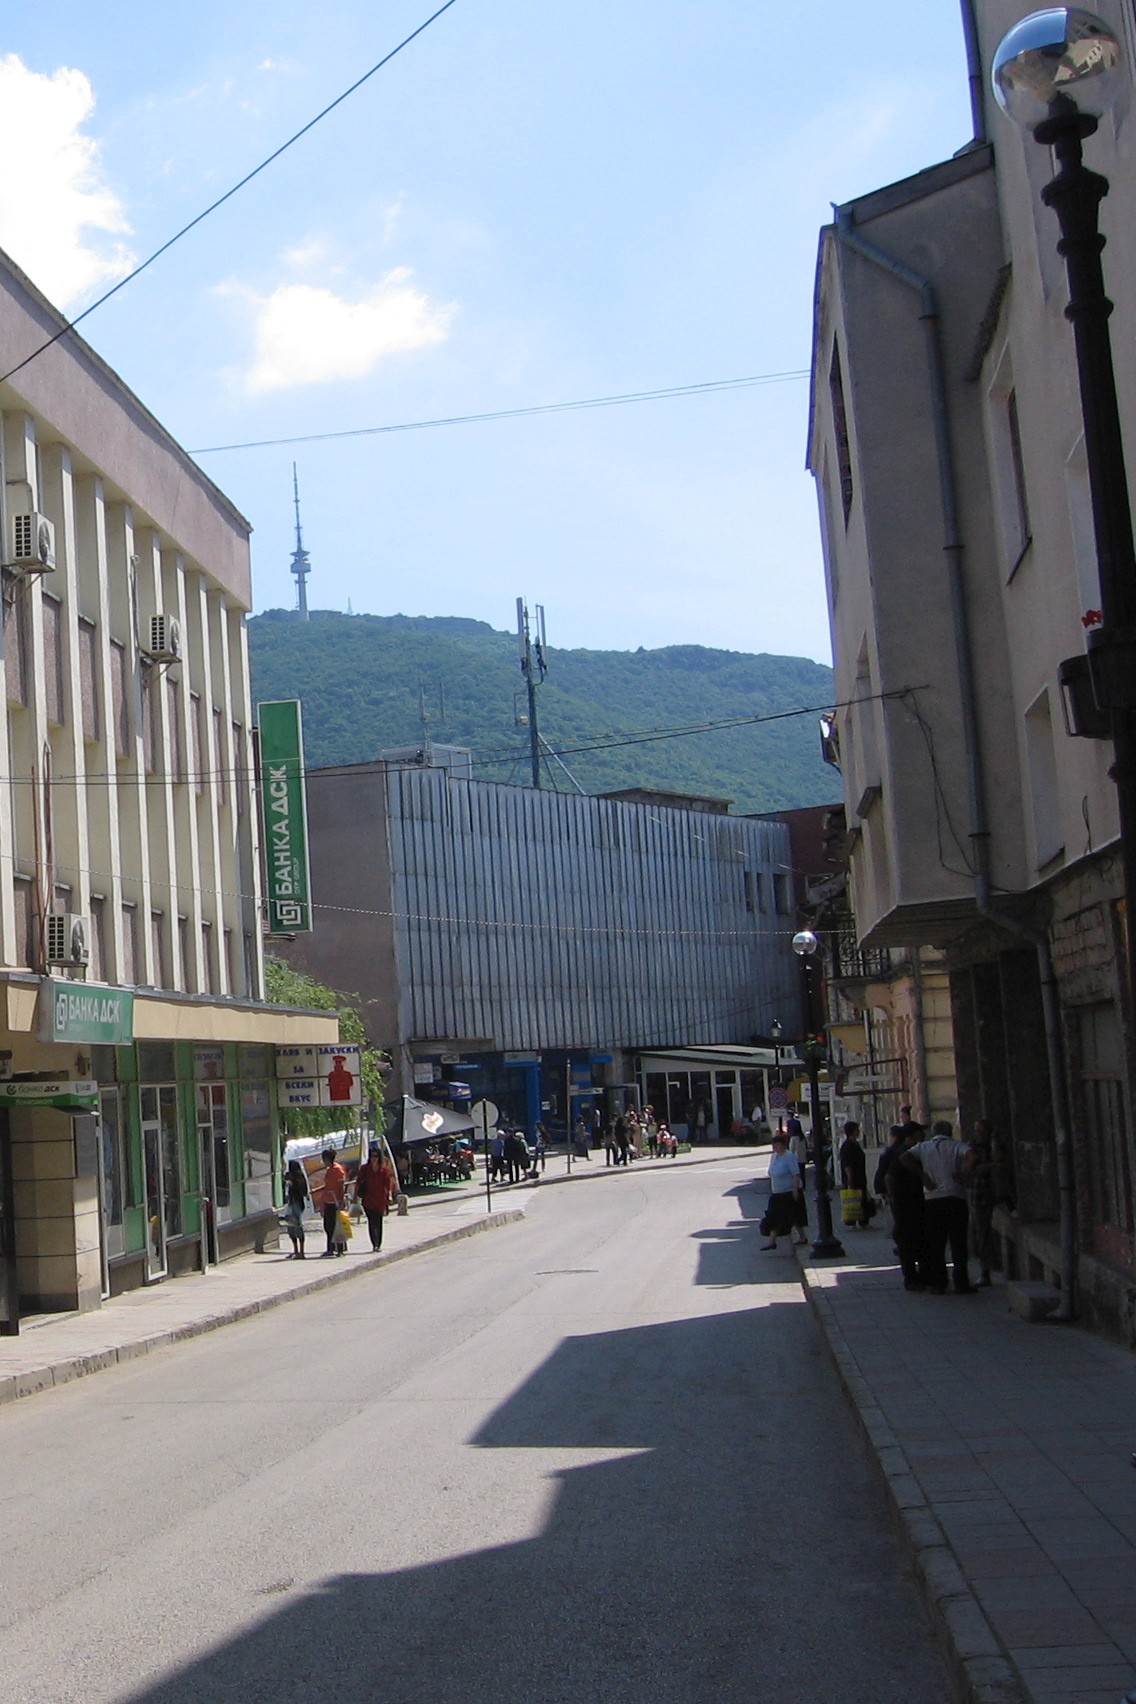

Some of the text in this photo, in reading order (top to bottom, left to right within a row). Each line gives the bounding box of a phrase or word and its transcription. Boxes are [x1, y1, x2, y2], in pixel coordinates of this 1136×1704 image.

[269, 764, 293, 895] БАНКА ДСК
[68, 995, 121, 1024] БАНКА ДСК
[318, 1046, 360, 1055] ЗАКУСКИ
[285, 1081, 314, 1089] ВСЕКИ
[288, 1095, 311, 1103] ВКУС
